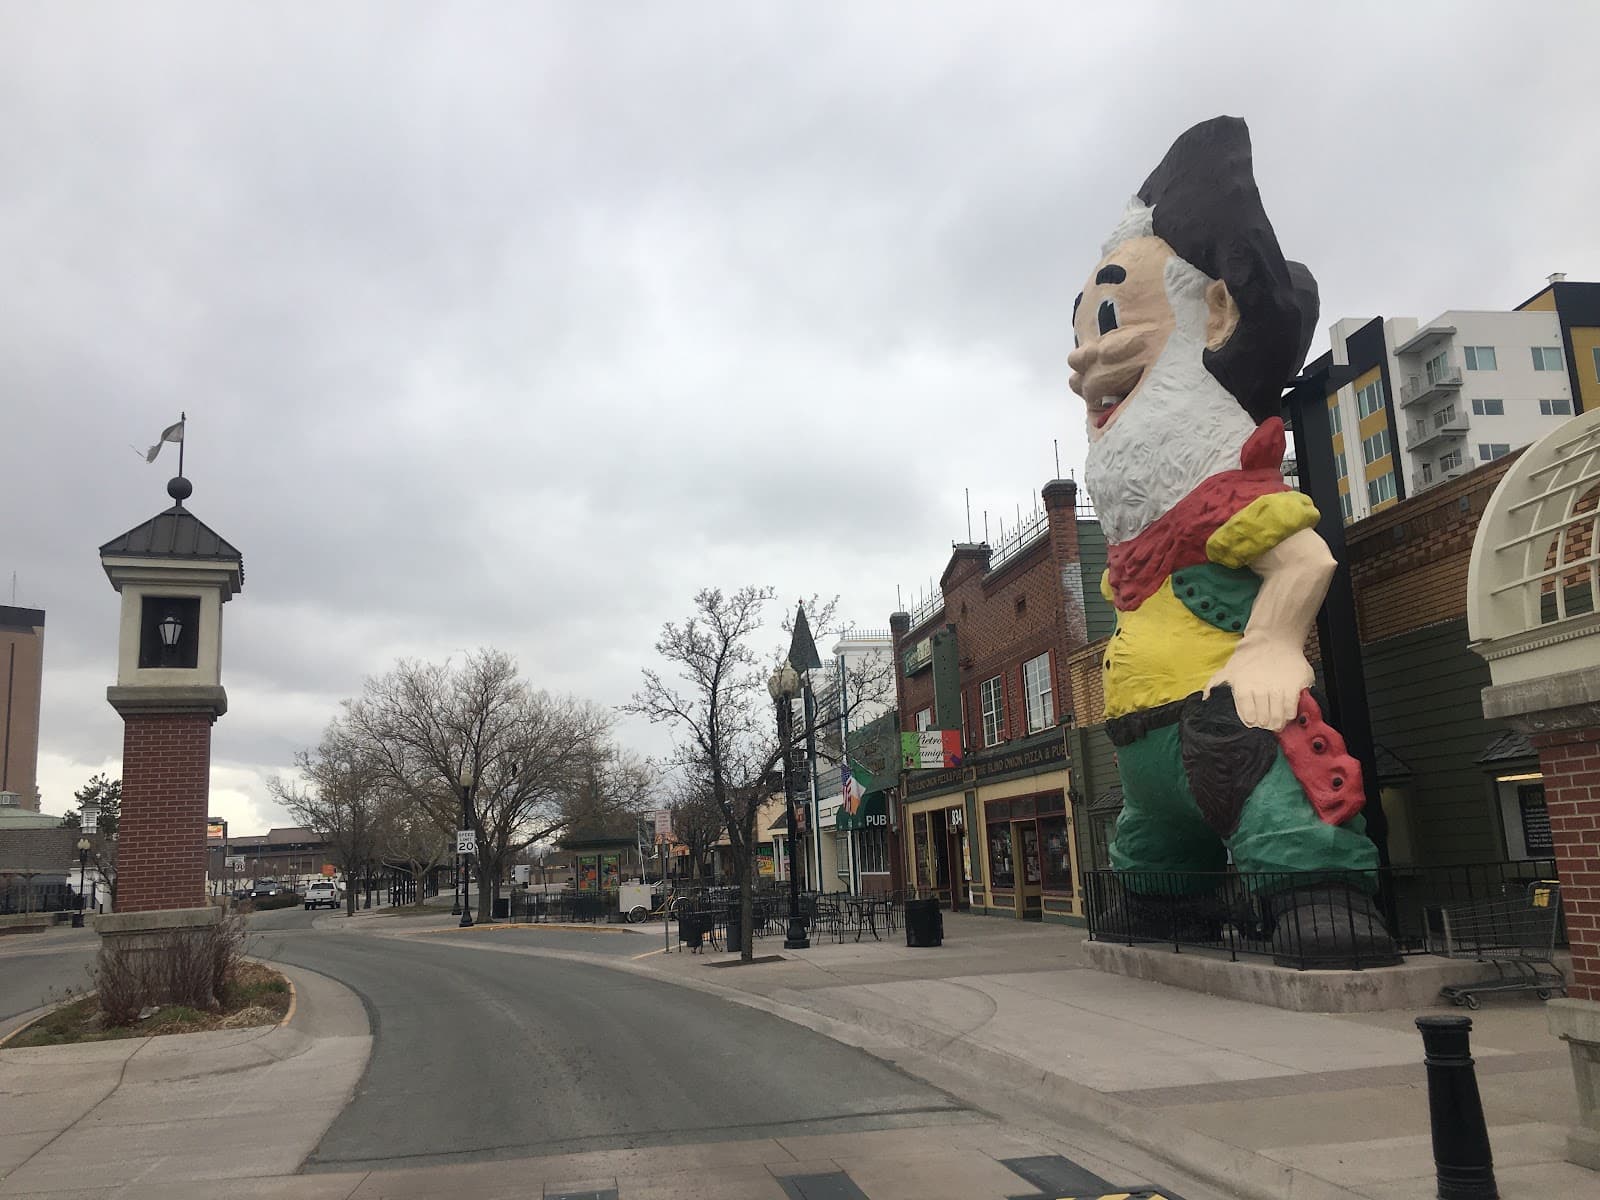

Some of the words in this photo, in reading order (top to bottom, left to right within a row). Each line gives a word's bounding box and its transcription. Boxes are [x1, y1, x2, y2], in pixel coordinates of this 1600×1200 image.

[1024, 749, 1043, 764] PIZZA
[866, 814, 887, 826] PUB
[951, 809, 962, 825] 83A
[459, 842, 473, 850] 20
